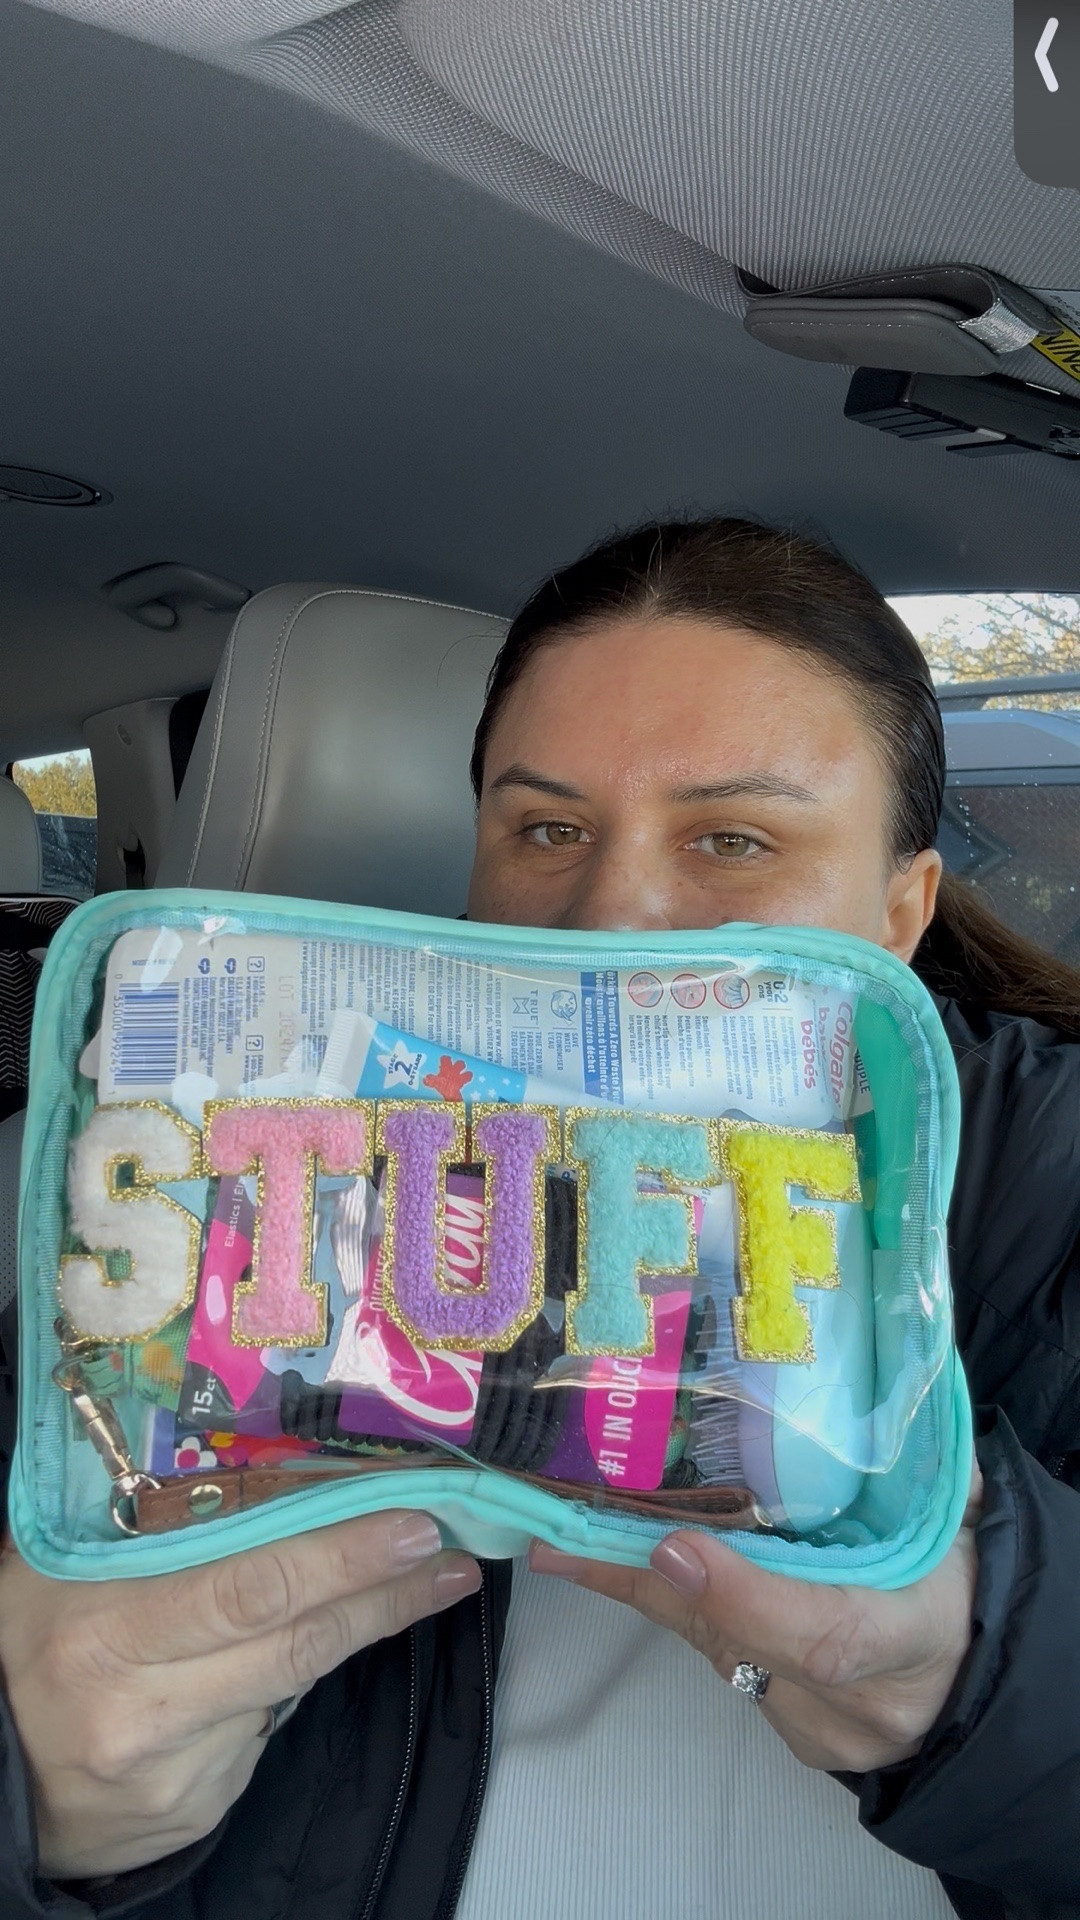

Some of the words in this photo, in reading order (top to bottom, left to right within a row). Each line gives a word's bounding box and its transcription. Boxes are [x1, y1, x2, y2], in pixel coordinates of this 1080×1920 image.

[278, 975, 296, 1001] LOT
[605, 971, 617, 996] orking
[757, 984, 766, 999] ans
[763, 981, 775, 1003] years
[773, 980, 789, 1004] 0-2
[112, 994, 124, 1031] 35000
[530, 989, 538, 1021] TRUE
[585, 997, 594, 1026] avenir
[607, 996, 617, 1032] Towards
[486, 1026, 494, 1051] visitez
[586, 1026, 595, 1044] zéro
[609, 1032, 617, 1040] A
[609, 1039, 619, 1058] Zero
[109, 1036, 122, 1072] 99245
[388, 1053, 399, 1075] STAGE
[511, 1047, 519, 1071] DÉCHET
[556, 1032, 564, 1071] ÉCONOMISER
[587, 1044, 597, 1073] déchet
[599, 1045, 610, 1083] l'atteinte
[800, 1020, 818, 1090] bébés
[829, 1001, 853, 1104] Colgate
[394, 1060, 412, 1076] 2
[610, 1059, 620, 1085] Waste
[57, 1096, 863, 1364] STUFF
[223, 1205, 241, 1248] Elastics
[191, 1376, 217, 1416] 15ct
[601, 1414, 634, 1442] IN
[597, 1448, 629, 1478] #1
